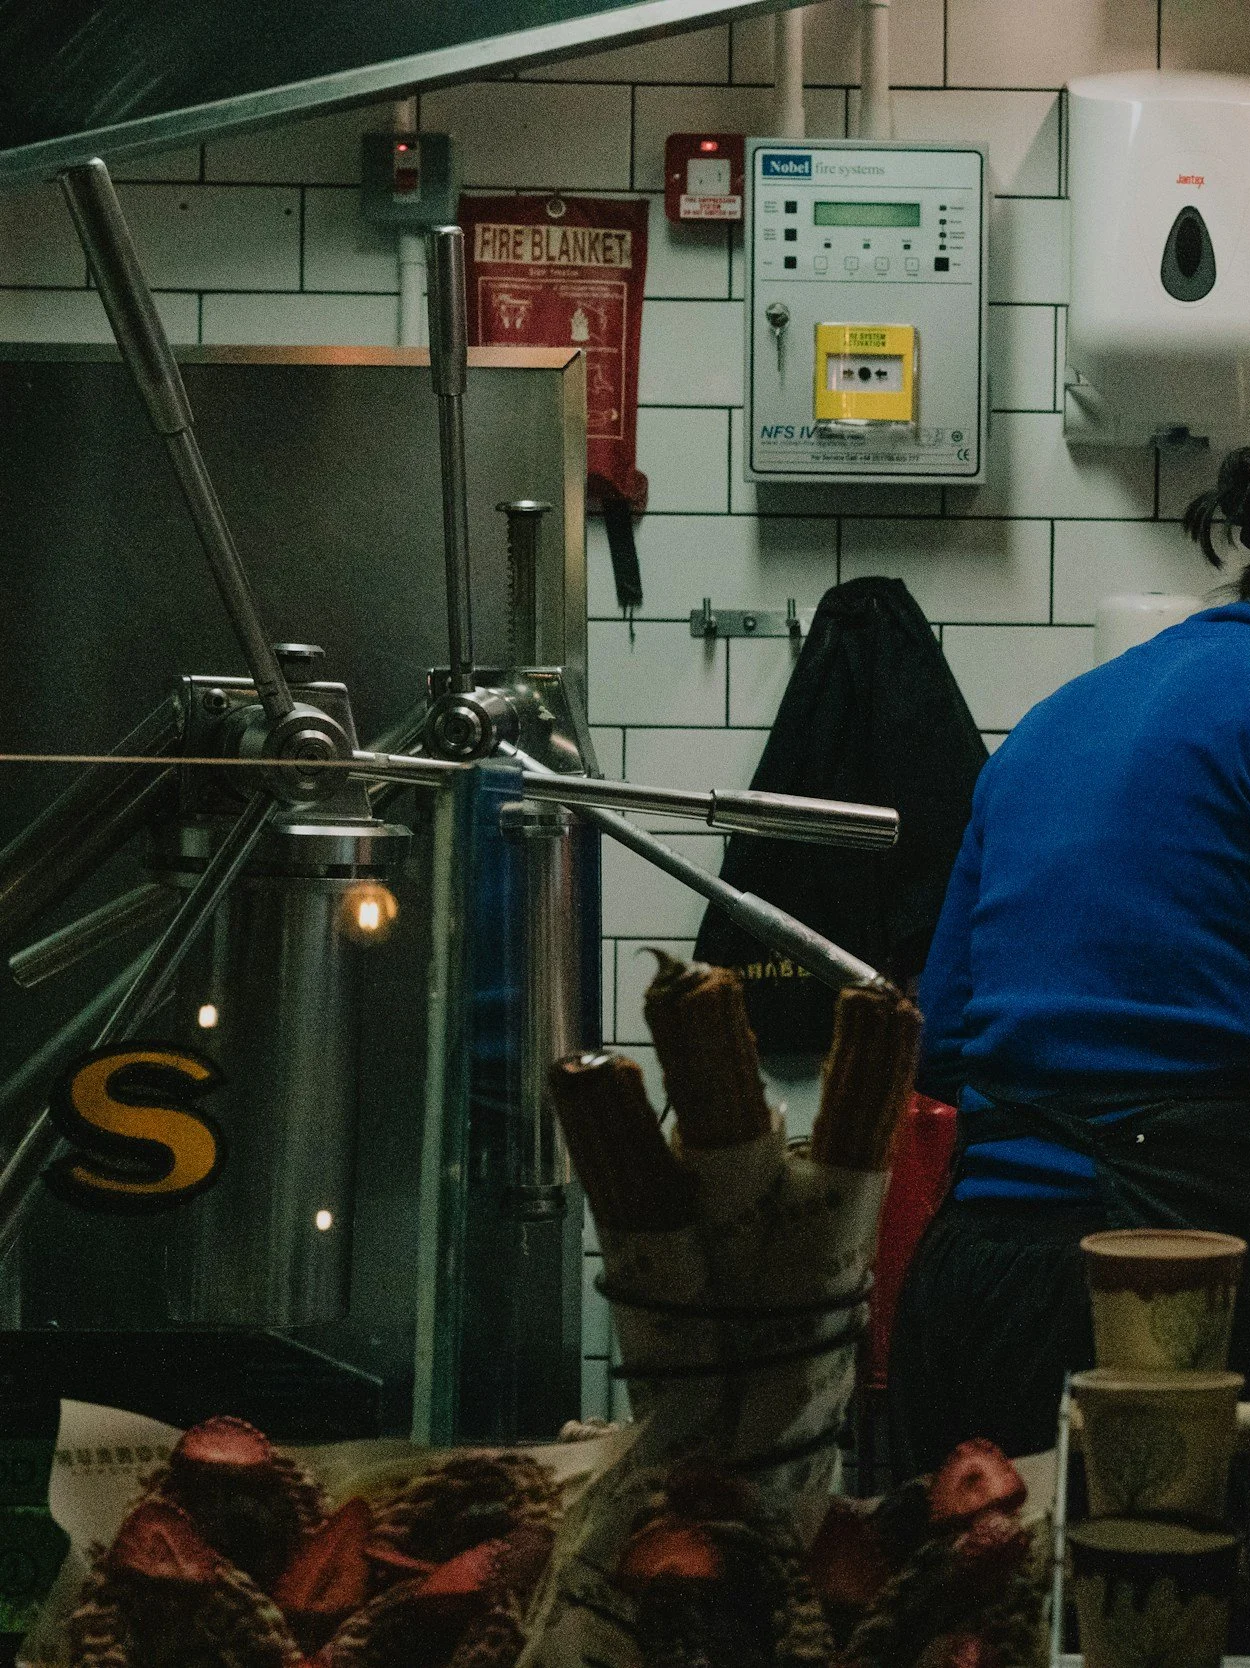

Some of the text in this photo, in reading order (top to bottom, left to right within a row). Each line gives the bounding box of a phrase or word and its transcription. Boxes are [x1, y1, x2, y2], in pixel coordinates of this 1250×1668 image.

[769, 160, 885, 178] Nobel fire systems
[1176, 173, 1206, 185] Jantex
[480, 226, 626, 265] FIRE BLANKET
[761, 425, 795, 439] NFS
[800, 426, 816, 440] IV
[71, 1051, 216, 1193] S
